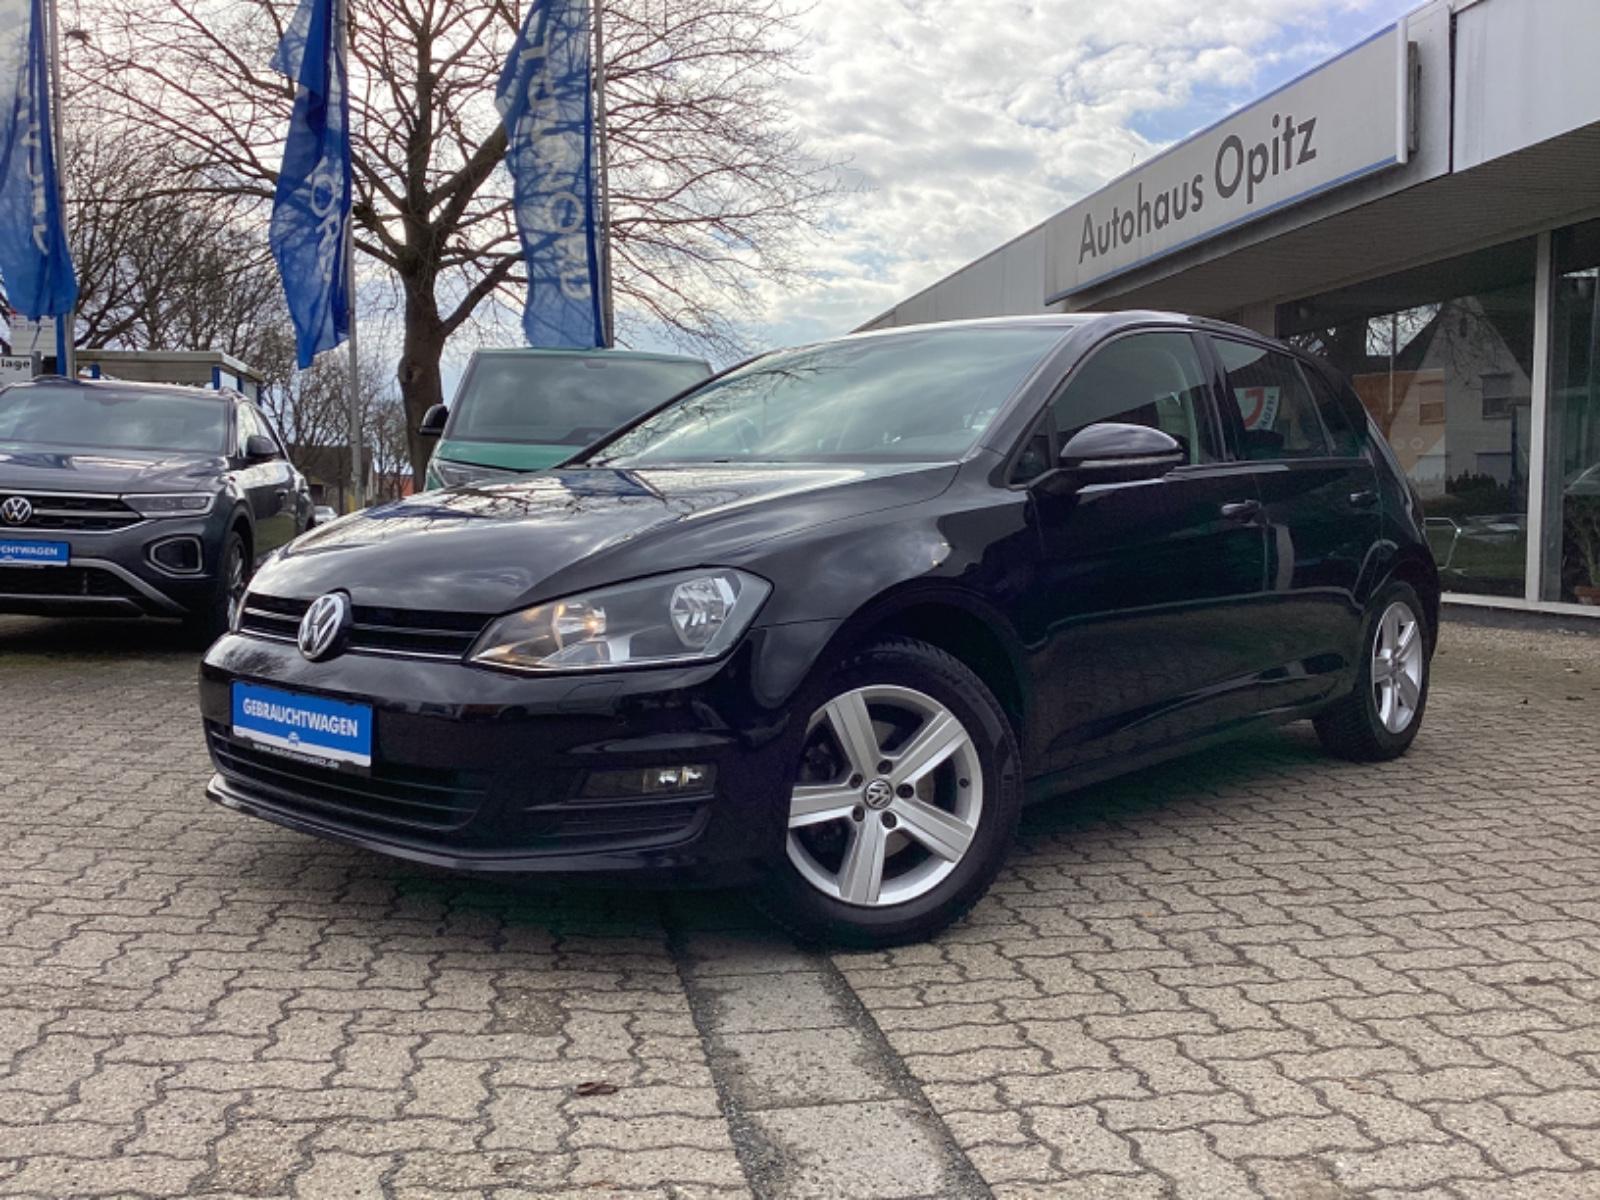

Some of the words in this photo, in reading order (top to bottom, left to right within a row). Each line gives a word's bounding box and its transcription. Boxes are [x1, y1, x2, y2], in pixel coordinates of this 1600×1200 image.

[1078, 174, 1204, 264] Autohaus
[1215, 114, 1317, 204] Opitz
[242, 697, 359, 738] GEBRAUCHTWAGEN
